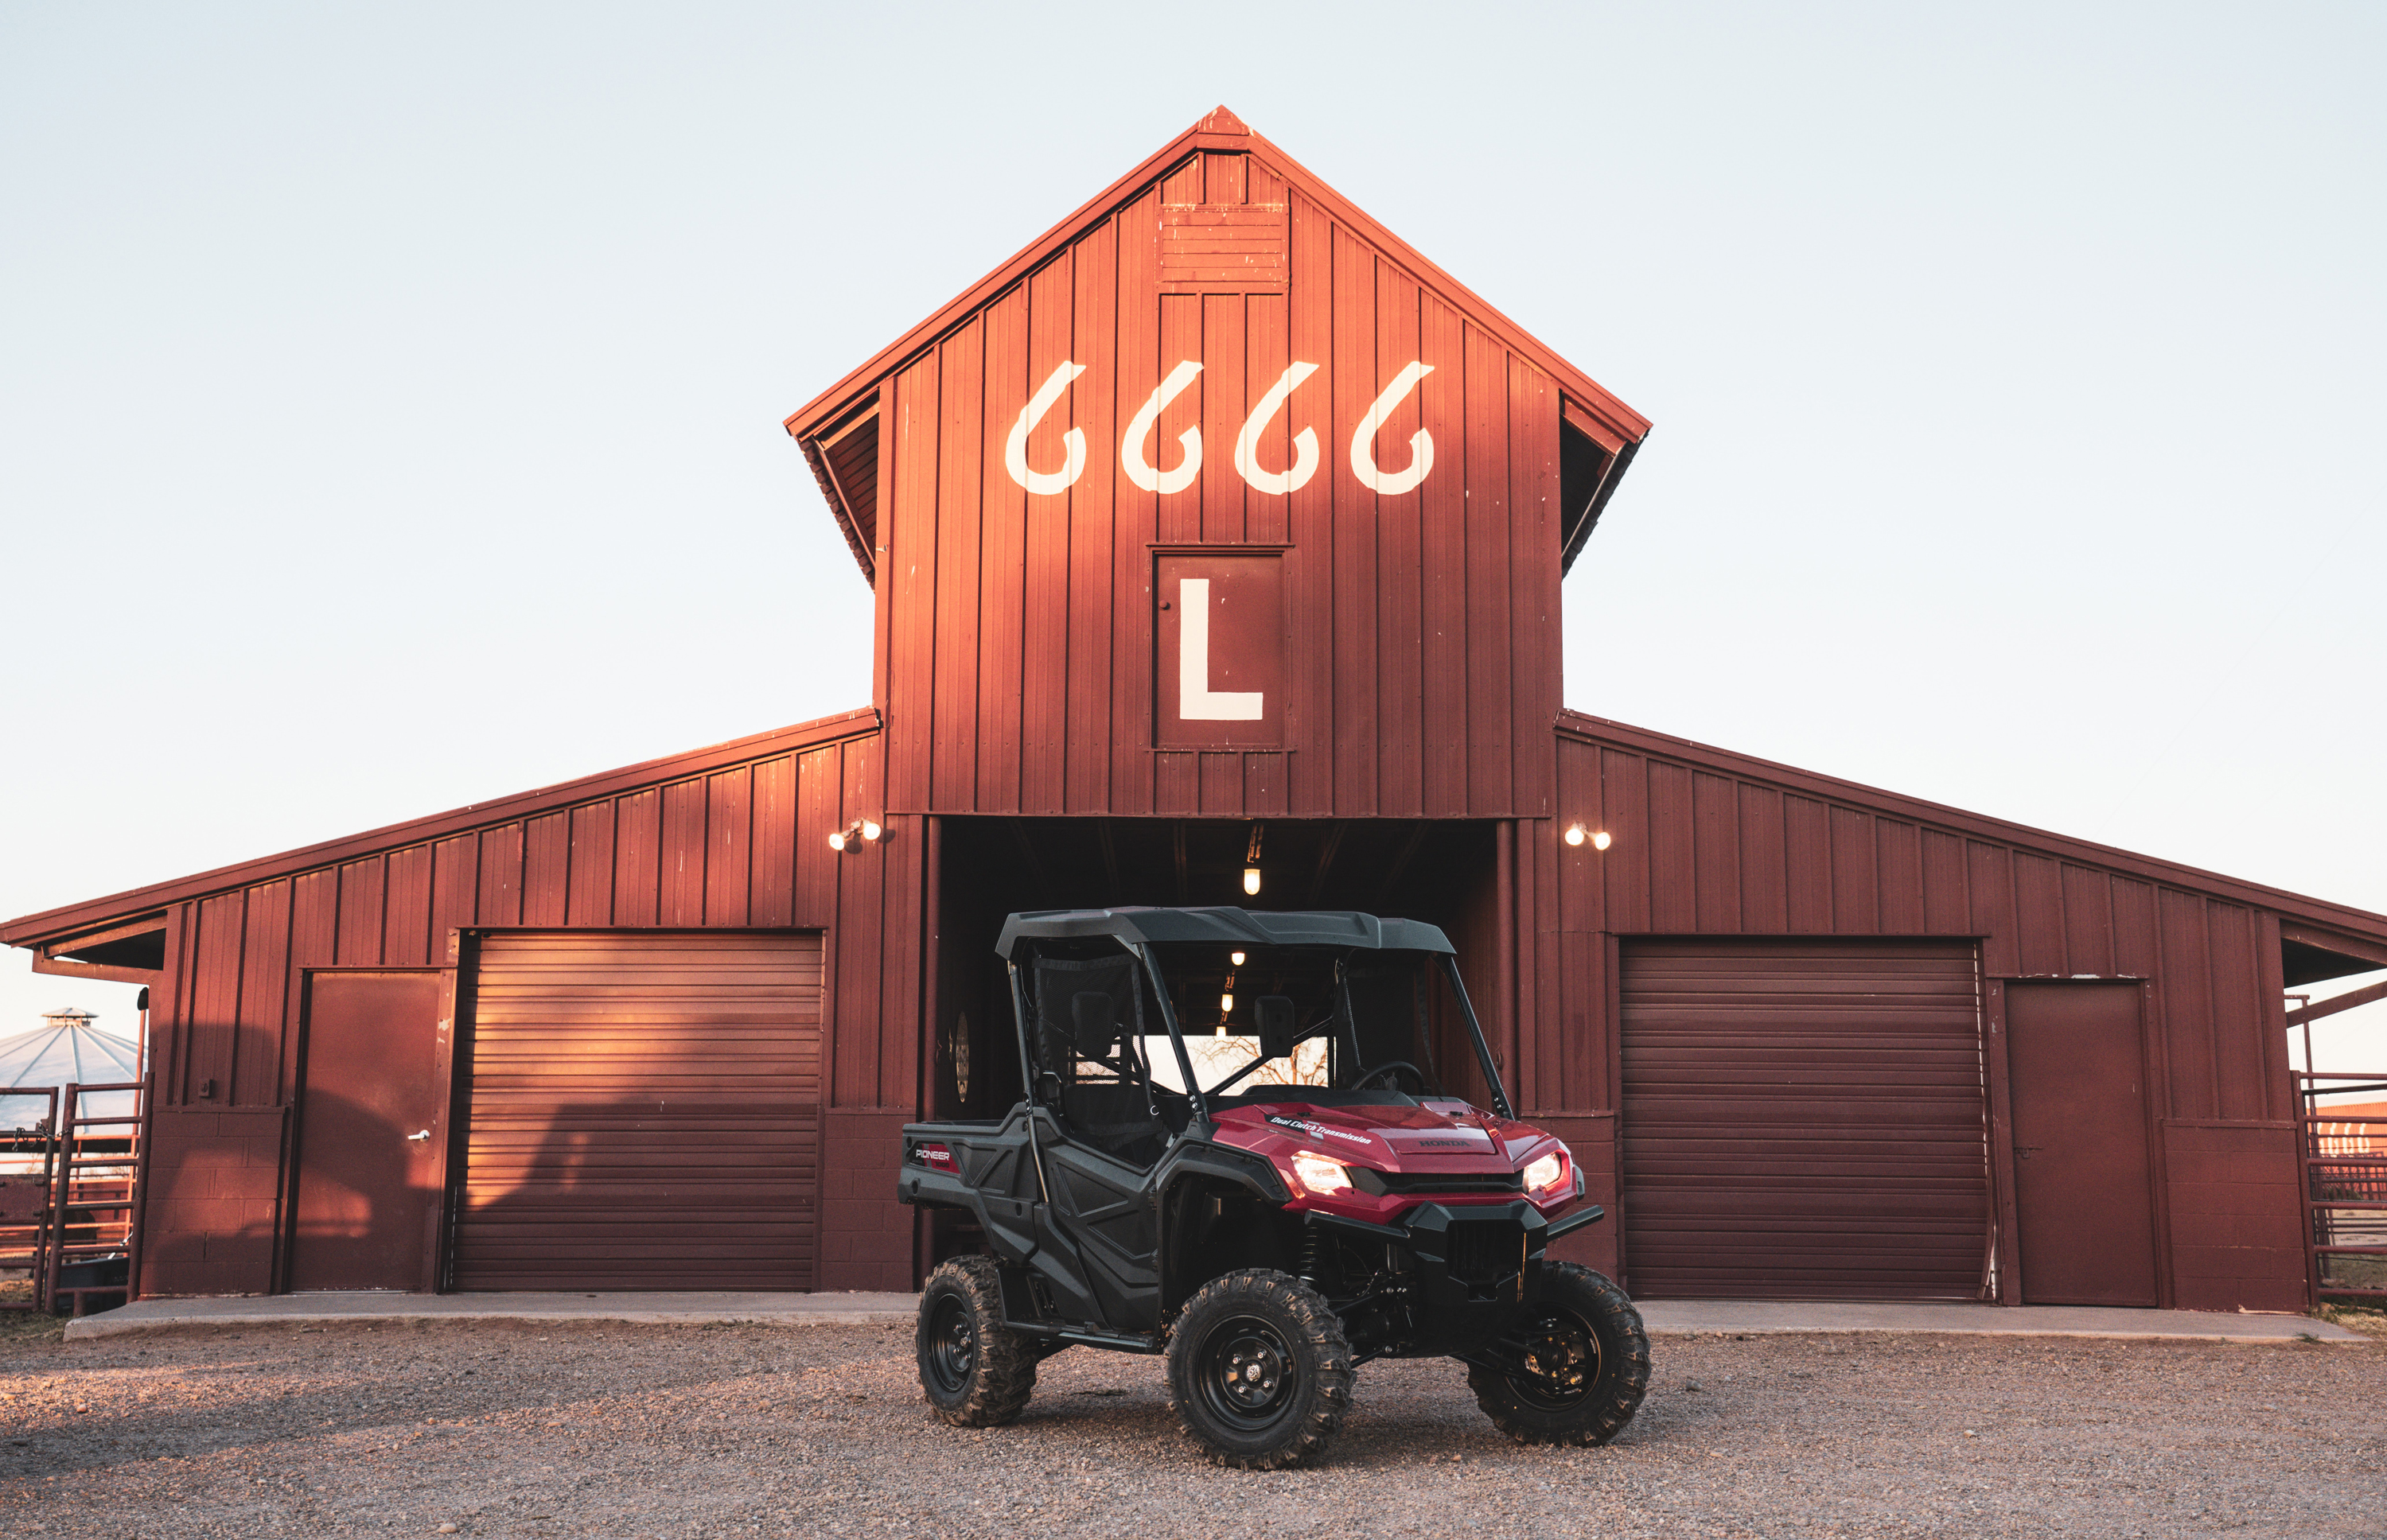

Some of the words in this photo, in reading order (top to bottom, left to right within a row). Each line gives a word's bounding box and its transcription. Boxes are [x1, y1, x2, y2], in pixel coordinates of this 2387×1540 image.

[1005, 360, 1435, 495] 6666
[1180, 579, 1264, 720] L
[916, 1149, 950, 1161] PIONEER
[1271, 1117, 1291, 1126] Dual
[1291, 1121, 1317, 1131] Clutch
[1317, 1126, 1372, 1144] Transmission
